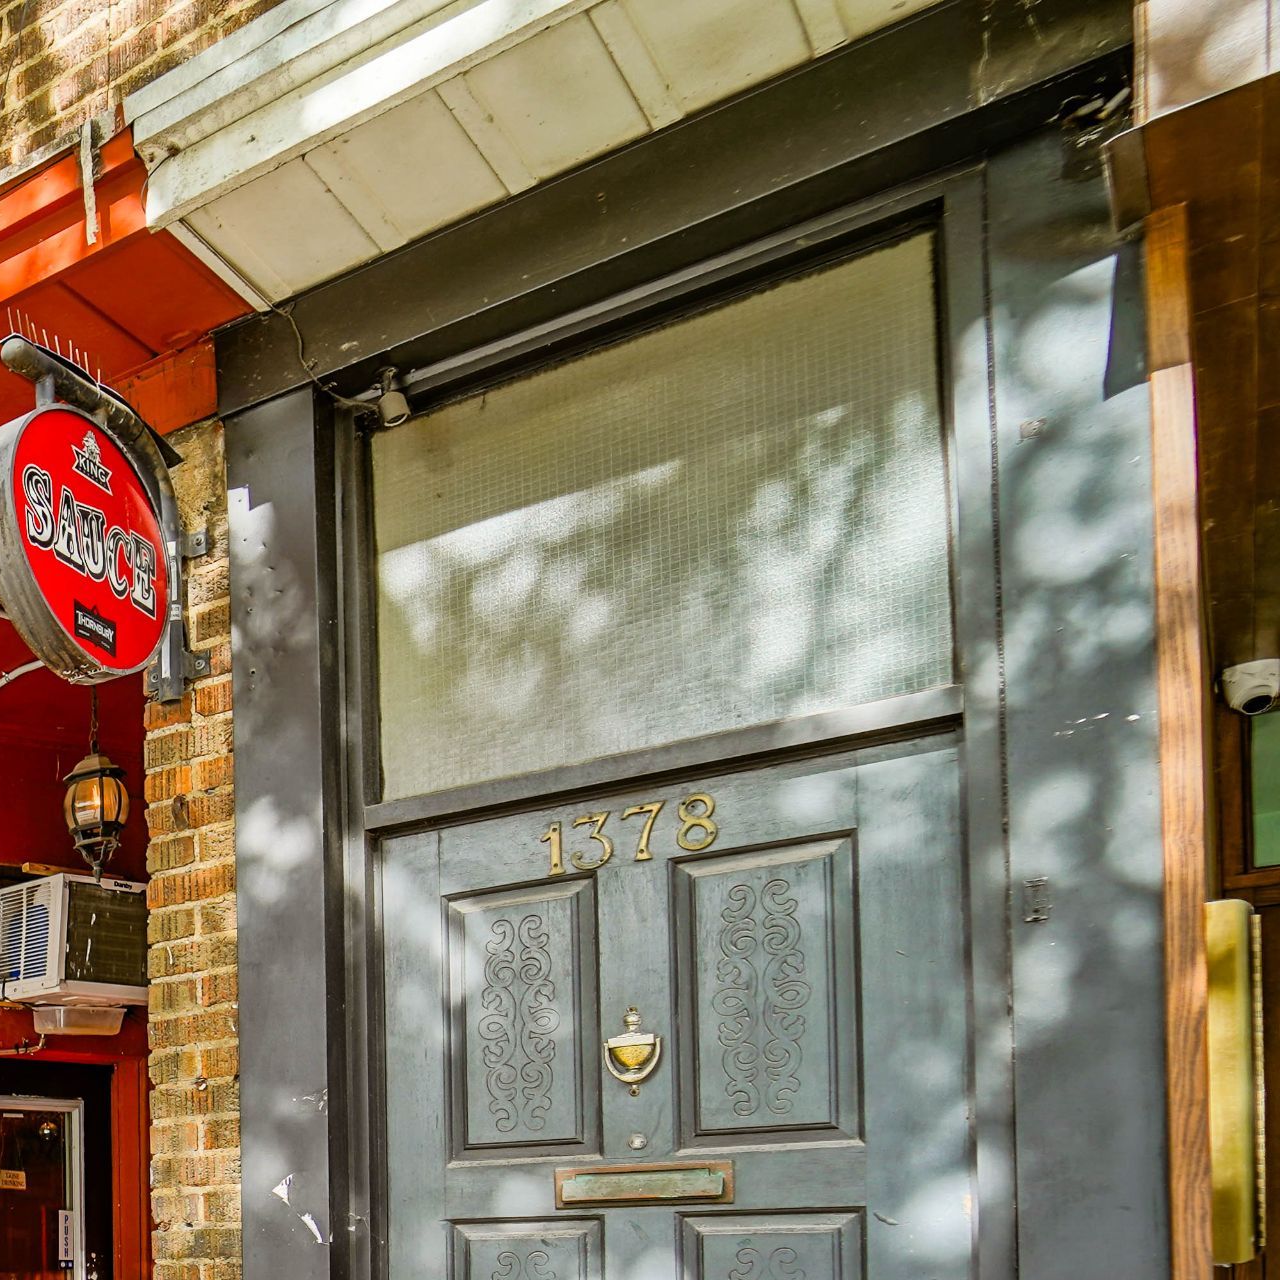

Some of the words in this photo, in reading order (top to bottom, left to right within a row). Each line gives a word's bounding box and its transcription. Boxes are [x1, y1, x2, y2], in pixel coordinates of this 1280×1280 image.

[79, 454, 106, 483] KING
[23, 464, 156, 620] SAUCE
[540, 792, 718, 876] 1378
